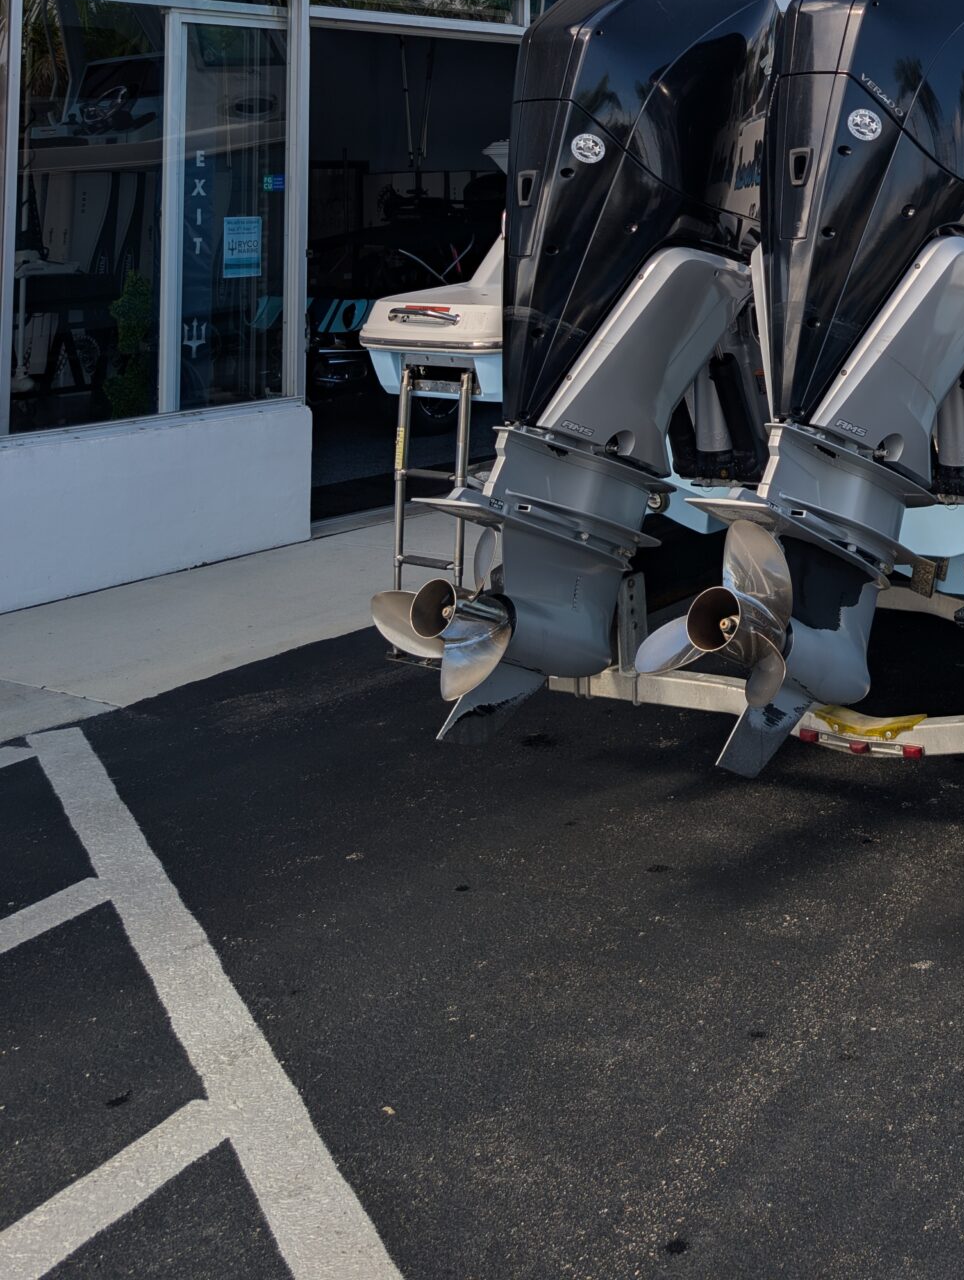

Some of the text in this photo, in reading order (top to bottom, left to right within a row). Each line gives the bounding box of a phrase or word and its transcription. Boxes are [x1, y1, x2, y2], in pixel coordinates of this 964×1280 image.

[861, 73, 904, 116] VERADO
[191, 150, 207, 255] EXIT
[237, 240, 259, 248] RYCO
[561, 420, 594, 437] AMS
[835, 419, 867, 437] AMS
